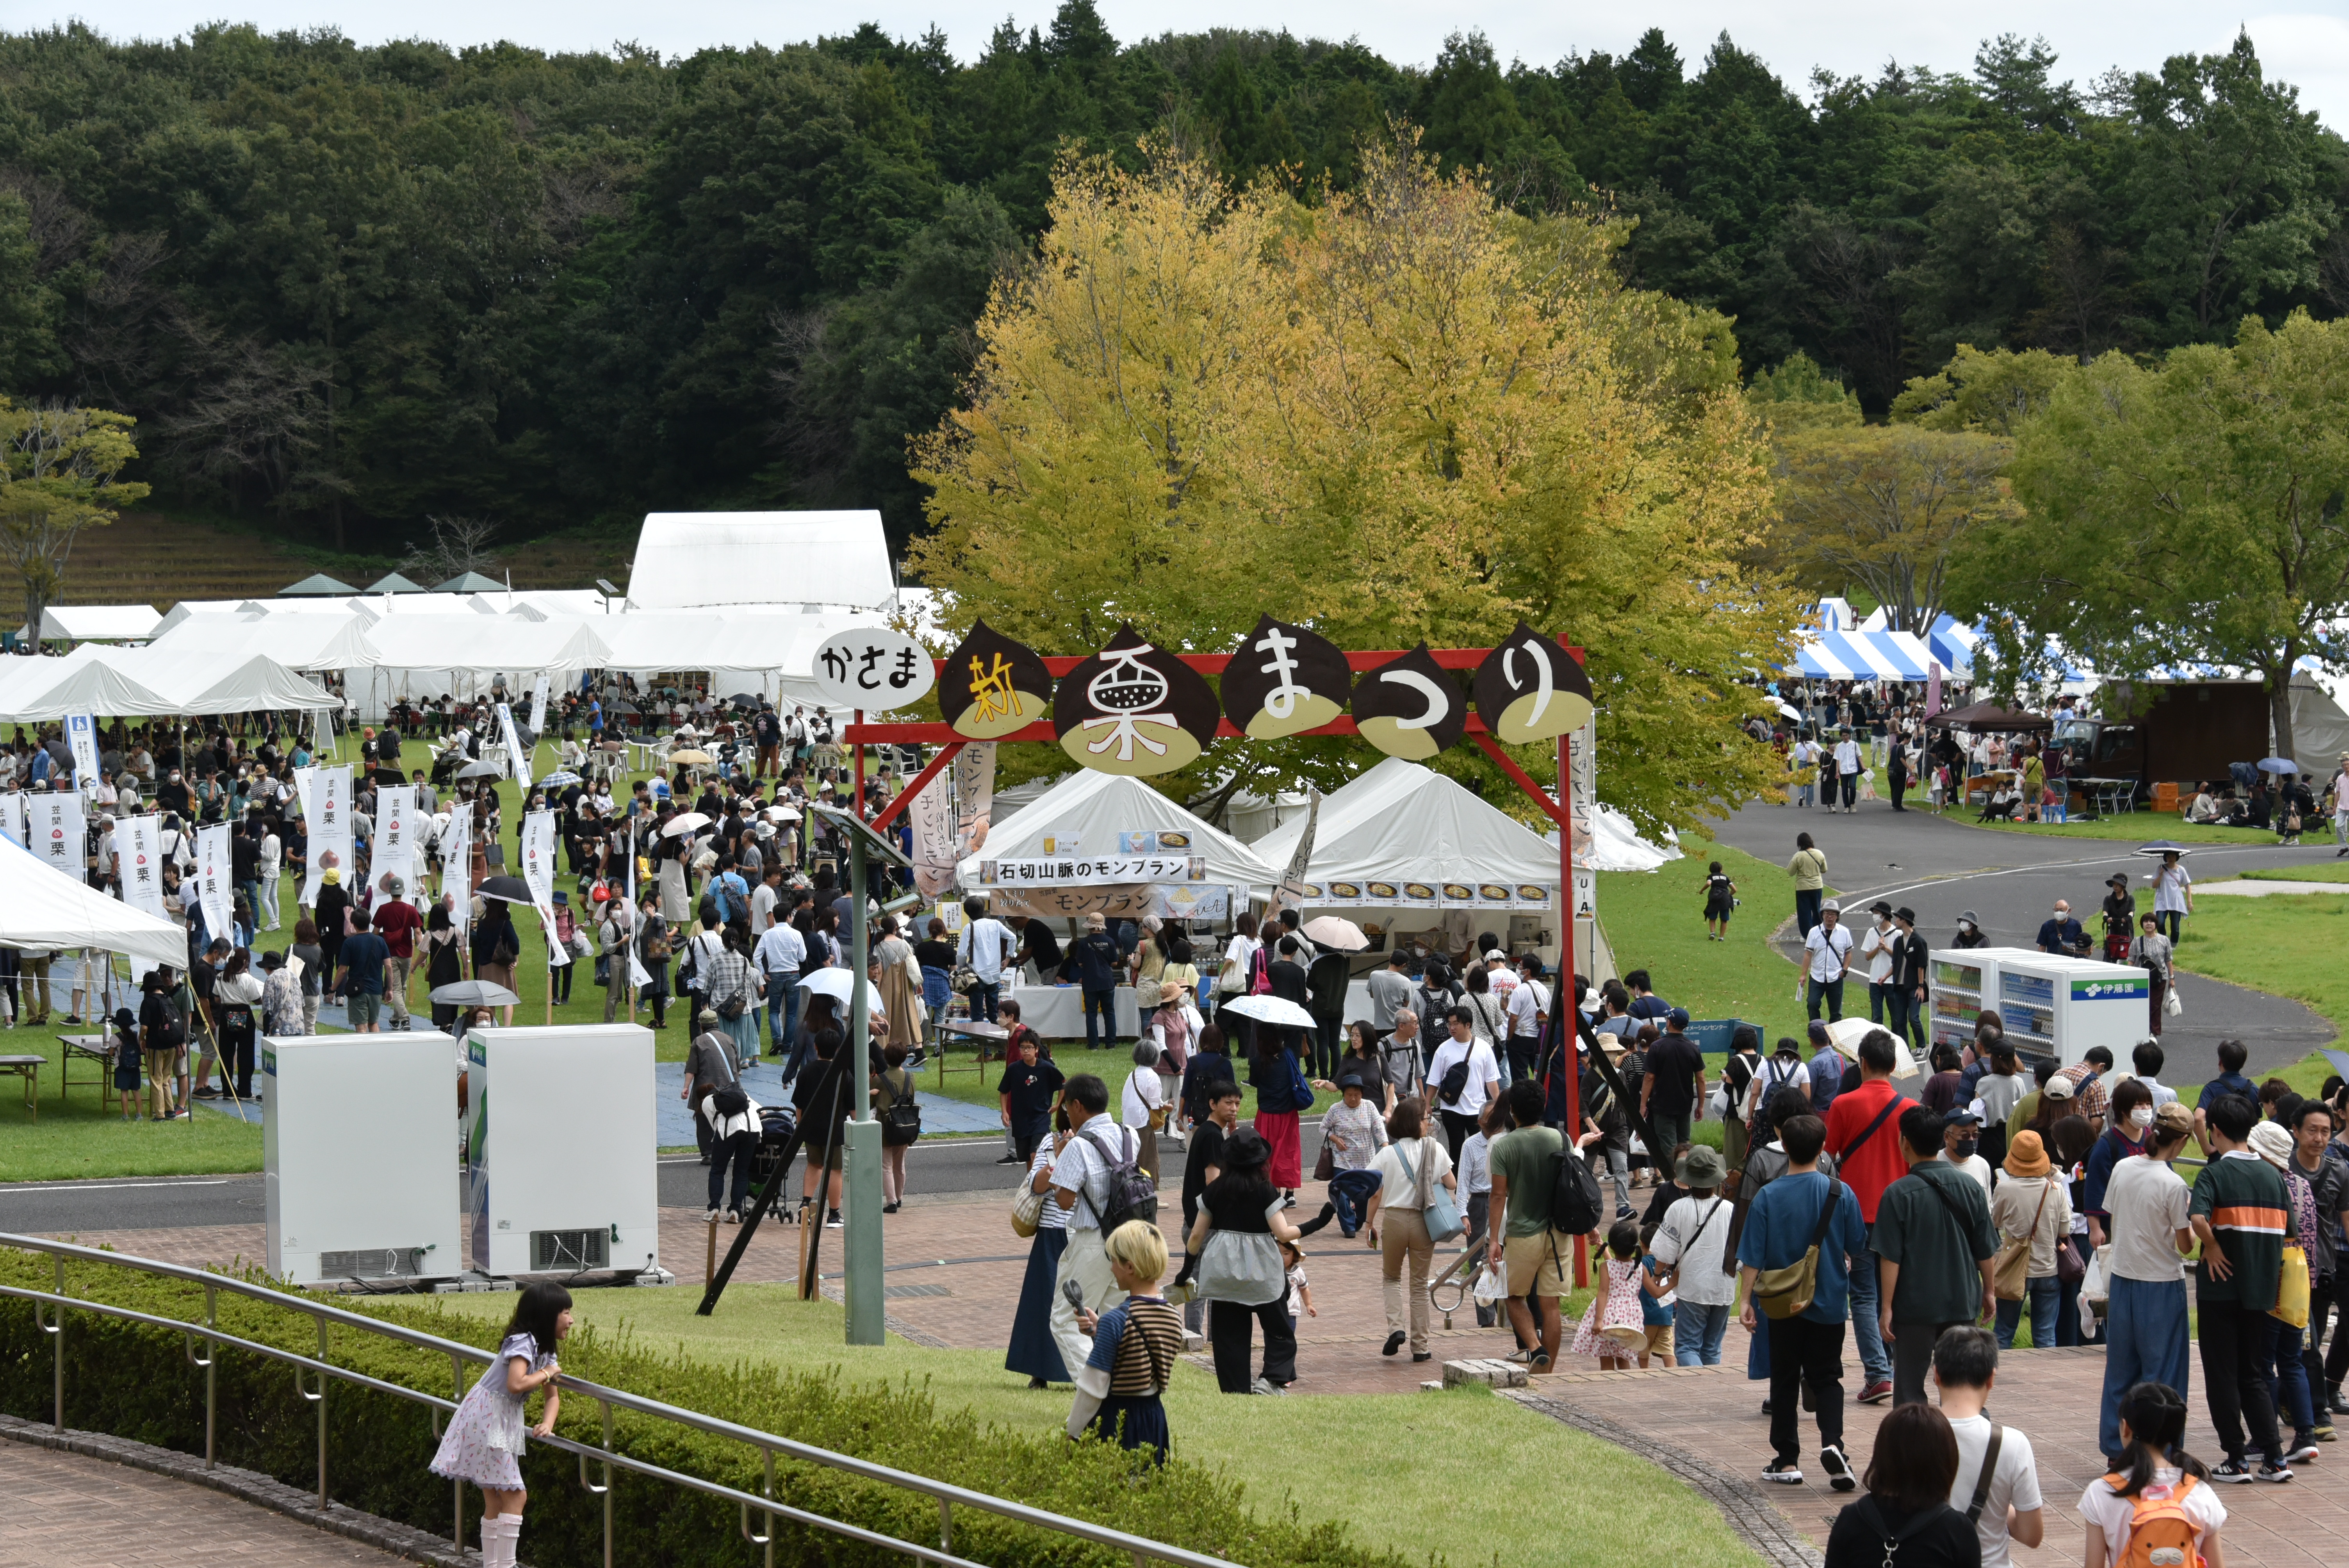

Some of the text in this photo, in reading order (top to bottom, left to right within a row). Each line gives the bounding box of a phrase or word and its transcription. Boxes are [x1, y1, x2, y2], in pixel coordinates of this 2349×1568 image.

[820, 646, 916, 689] かさま
[539, 680, 548, 707] キッズ専用
[531, 693, 539, 727] 休憩スペース
[1000, 859, 1183, 880] 石切山脈のモンブラン
[1039, 888, 1057, 897] 笠間栗
[1055, 893, 1152, 911] モンブラン
[999, 898, 1030, 907] 絞りたて
[2103, 983, 2133, 994] 伊藤園
